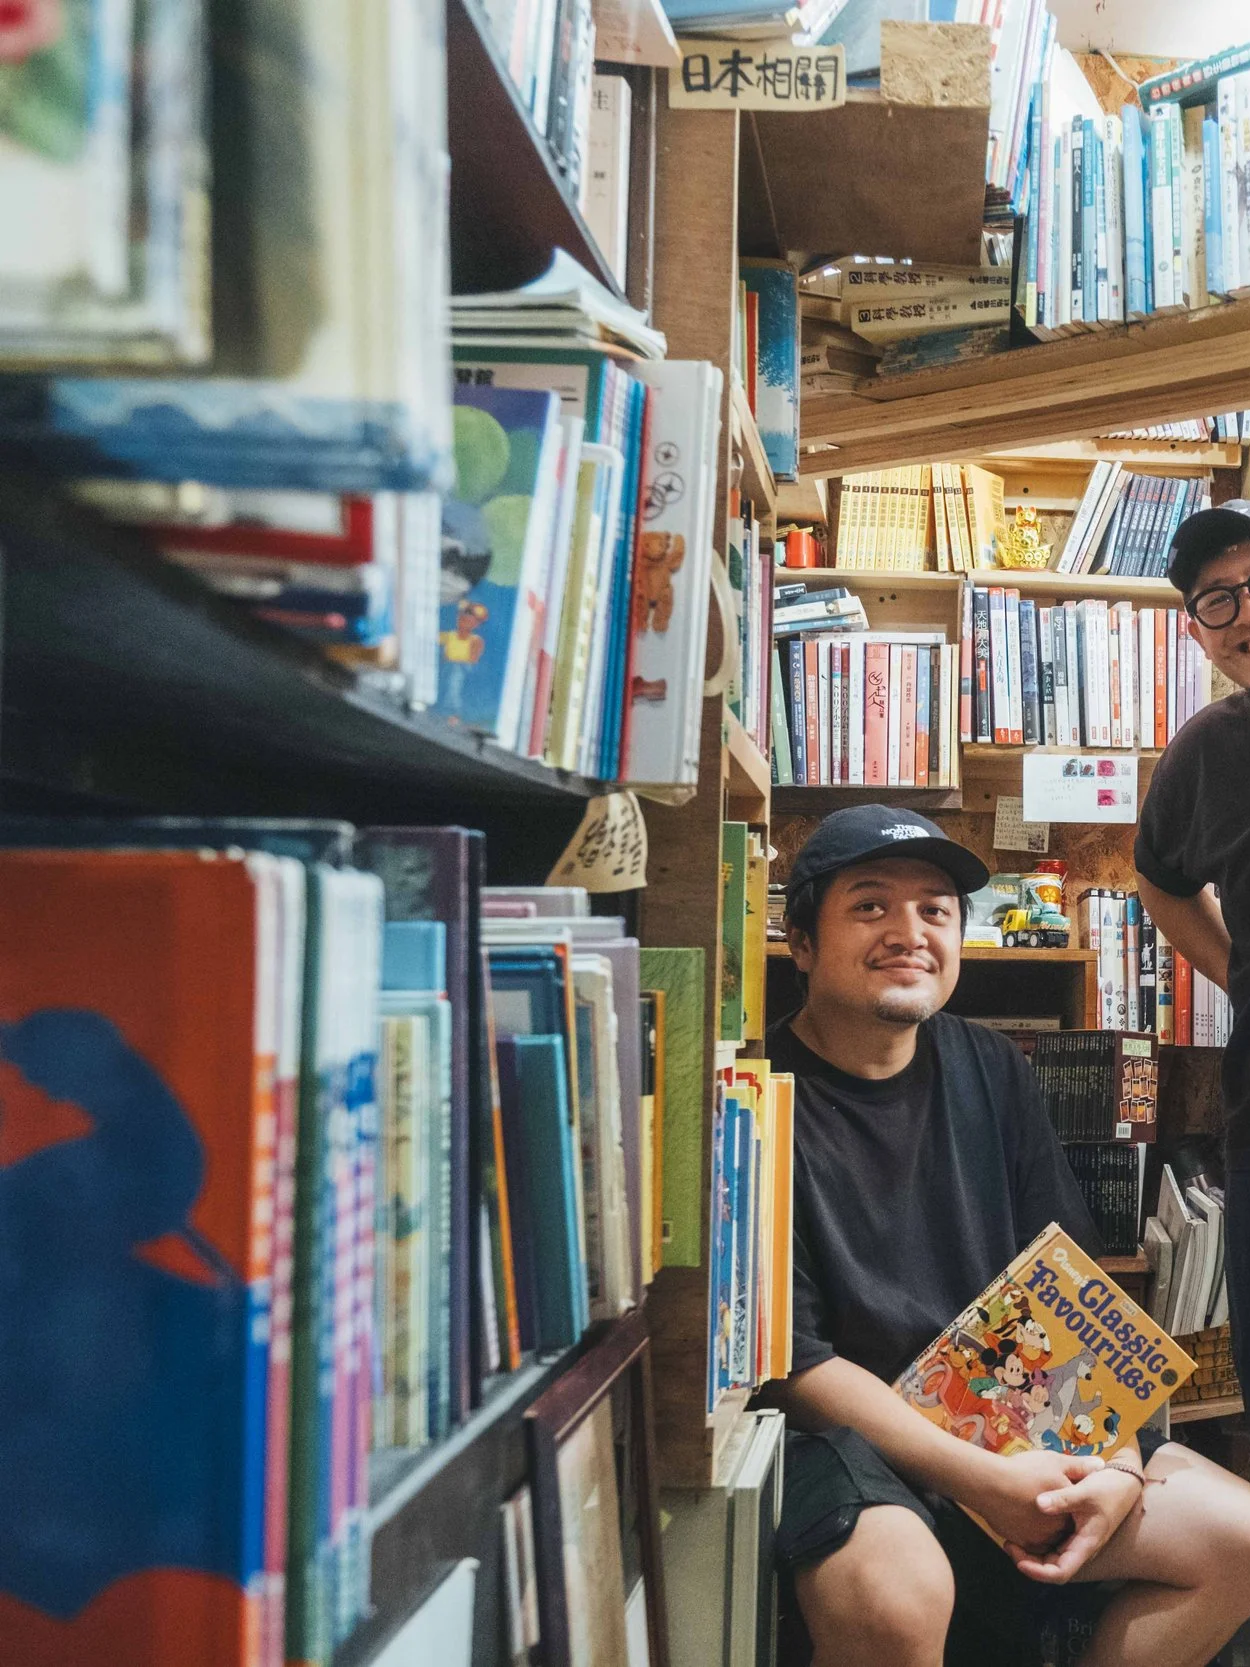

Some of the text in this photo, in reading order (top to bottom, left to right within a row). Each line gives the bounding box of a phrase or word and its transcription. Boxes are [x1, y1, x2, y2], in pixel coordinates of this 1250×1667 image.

[683, 49, 839, 101] 日本相關
[1024, 1259, 1157, 1401] Favourites
[1078, 1278, 1169, 1374] Classic
